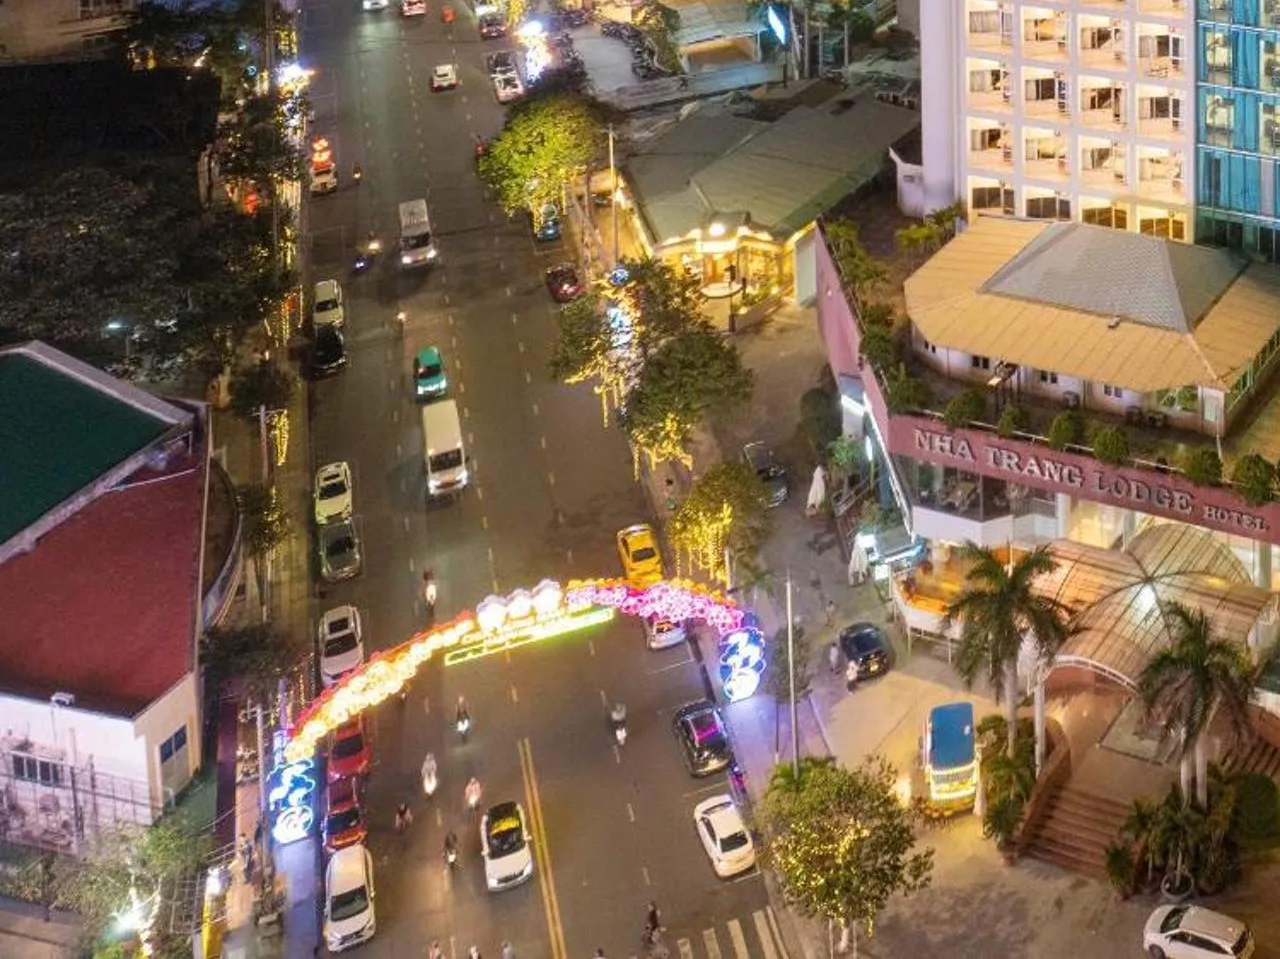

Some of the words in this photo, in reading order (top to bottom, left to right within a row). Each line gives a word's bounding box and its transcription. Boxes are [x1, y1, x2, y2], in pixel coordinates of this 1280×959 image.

[914, 429, 976, 463] NHA
[983, 445, 1084, 487] TRANG
[1094, 470, 1194, 515] LODGE
[1202, 505, 1270, 531] HOTEL
